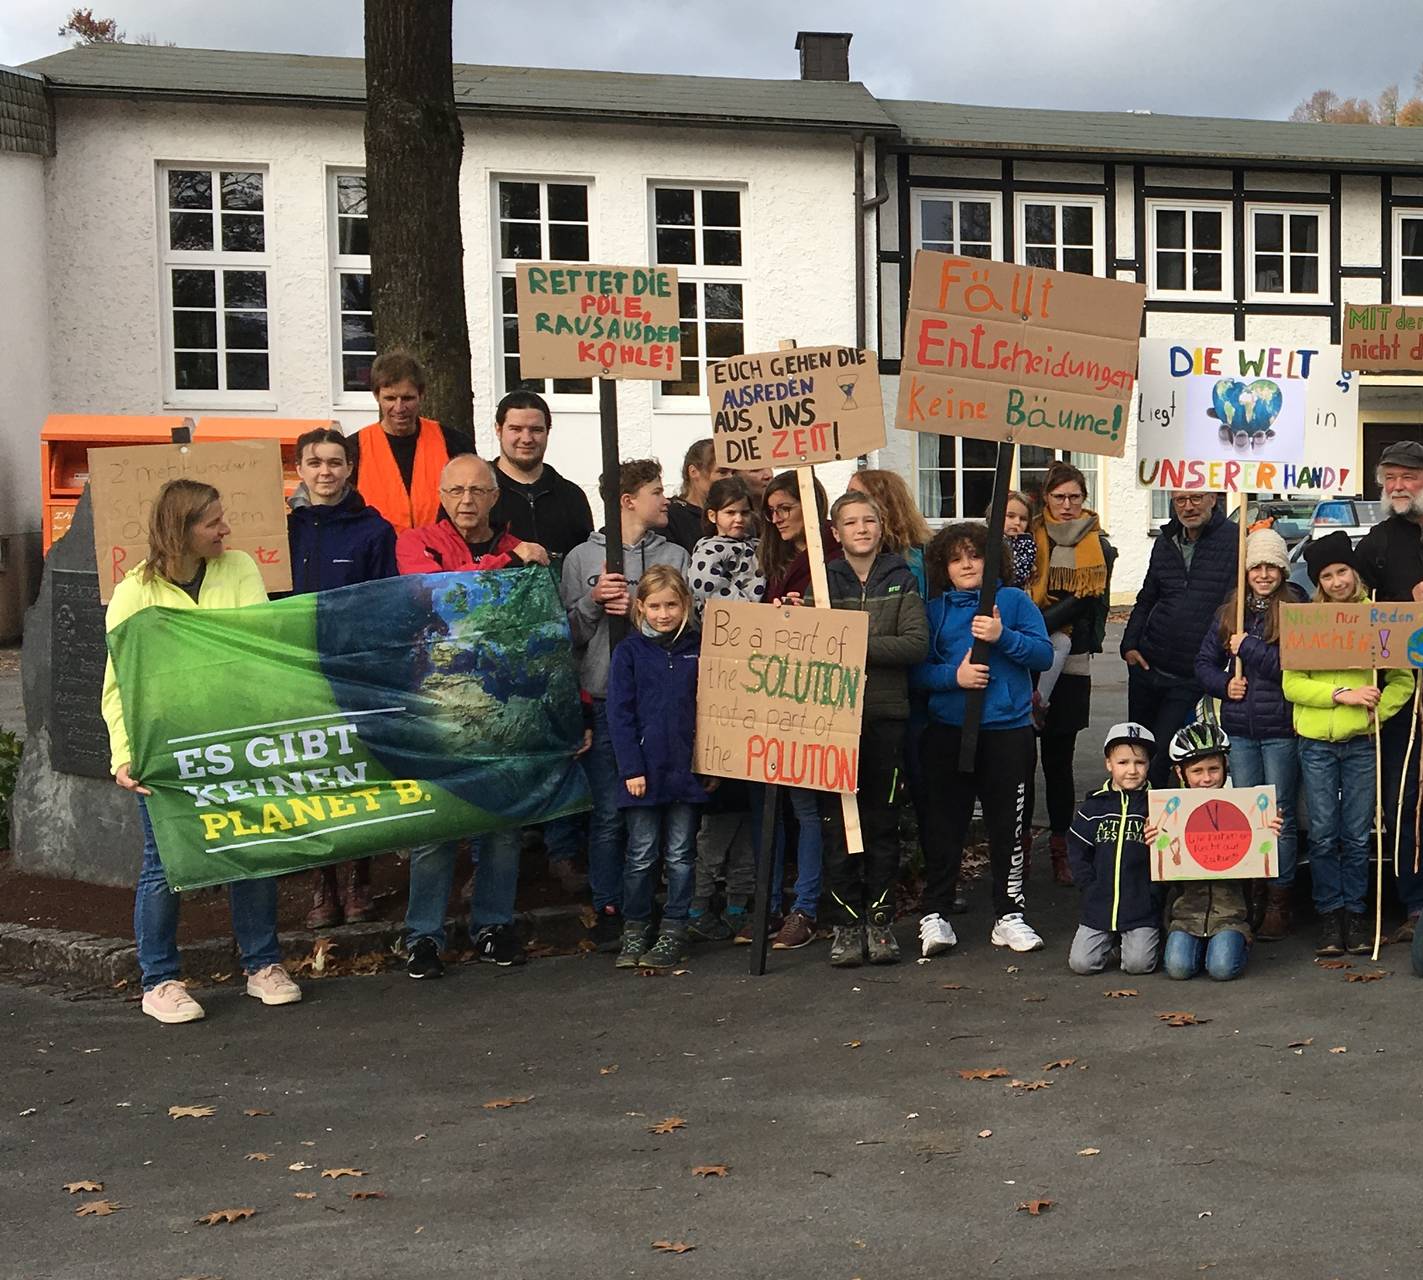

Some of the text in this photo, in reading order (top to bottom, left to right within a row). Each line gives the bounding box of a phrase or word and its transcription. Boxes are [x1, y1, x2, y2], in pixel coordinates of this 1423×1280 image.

[528, 267, 628, 295] RETTET
[939, 259, 1054, 318] Fällt
[1349, 307, 1392, 331] MIT
[578, 340, 675, 371] KOHLE!
[714, 348, 867, 385] EUCH GEHEN DIE
[917, 319, 1134, 391] Entscheidungen
[1170, 346, 1319, 379] DIE WELT
[1350, 333, 1400, 360] nicht
[722, 376, 814, 410] AUSREDEN
[714, 398, 815, 435] AUS, UNS
[1006, 388, 1123, 441] Bäume!
[1316, 408, 1337, 427] in
[726, 421, 841, 464] DIE ZEIT!
[1139, 458, 1350, 492] UNSERER HAND!
[711, 609, 849, 663] Be a part of
[1335, 611, 1360, 625] nur
[707, 653, 860, 713] the SOLUTION
[708, 696, 839, 742] not a part of
[173, 723, 358, 780] ES GIBT
[704, 734, 858, 792] the POLUTION
[183, 761, 368, 808] KEINEN
[200, 779, 431, 840] PLANET B.
